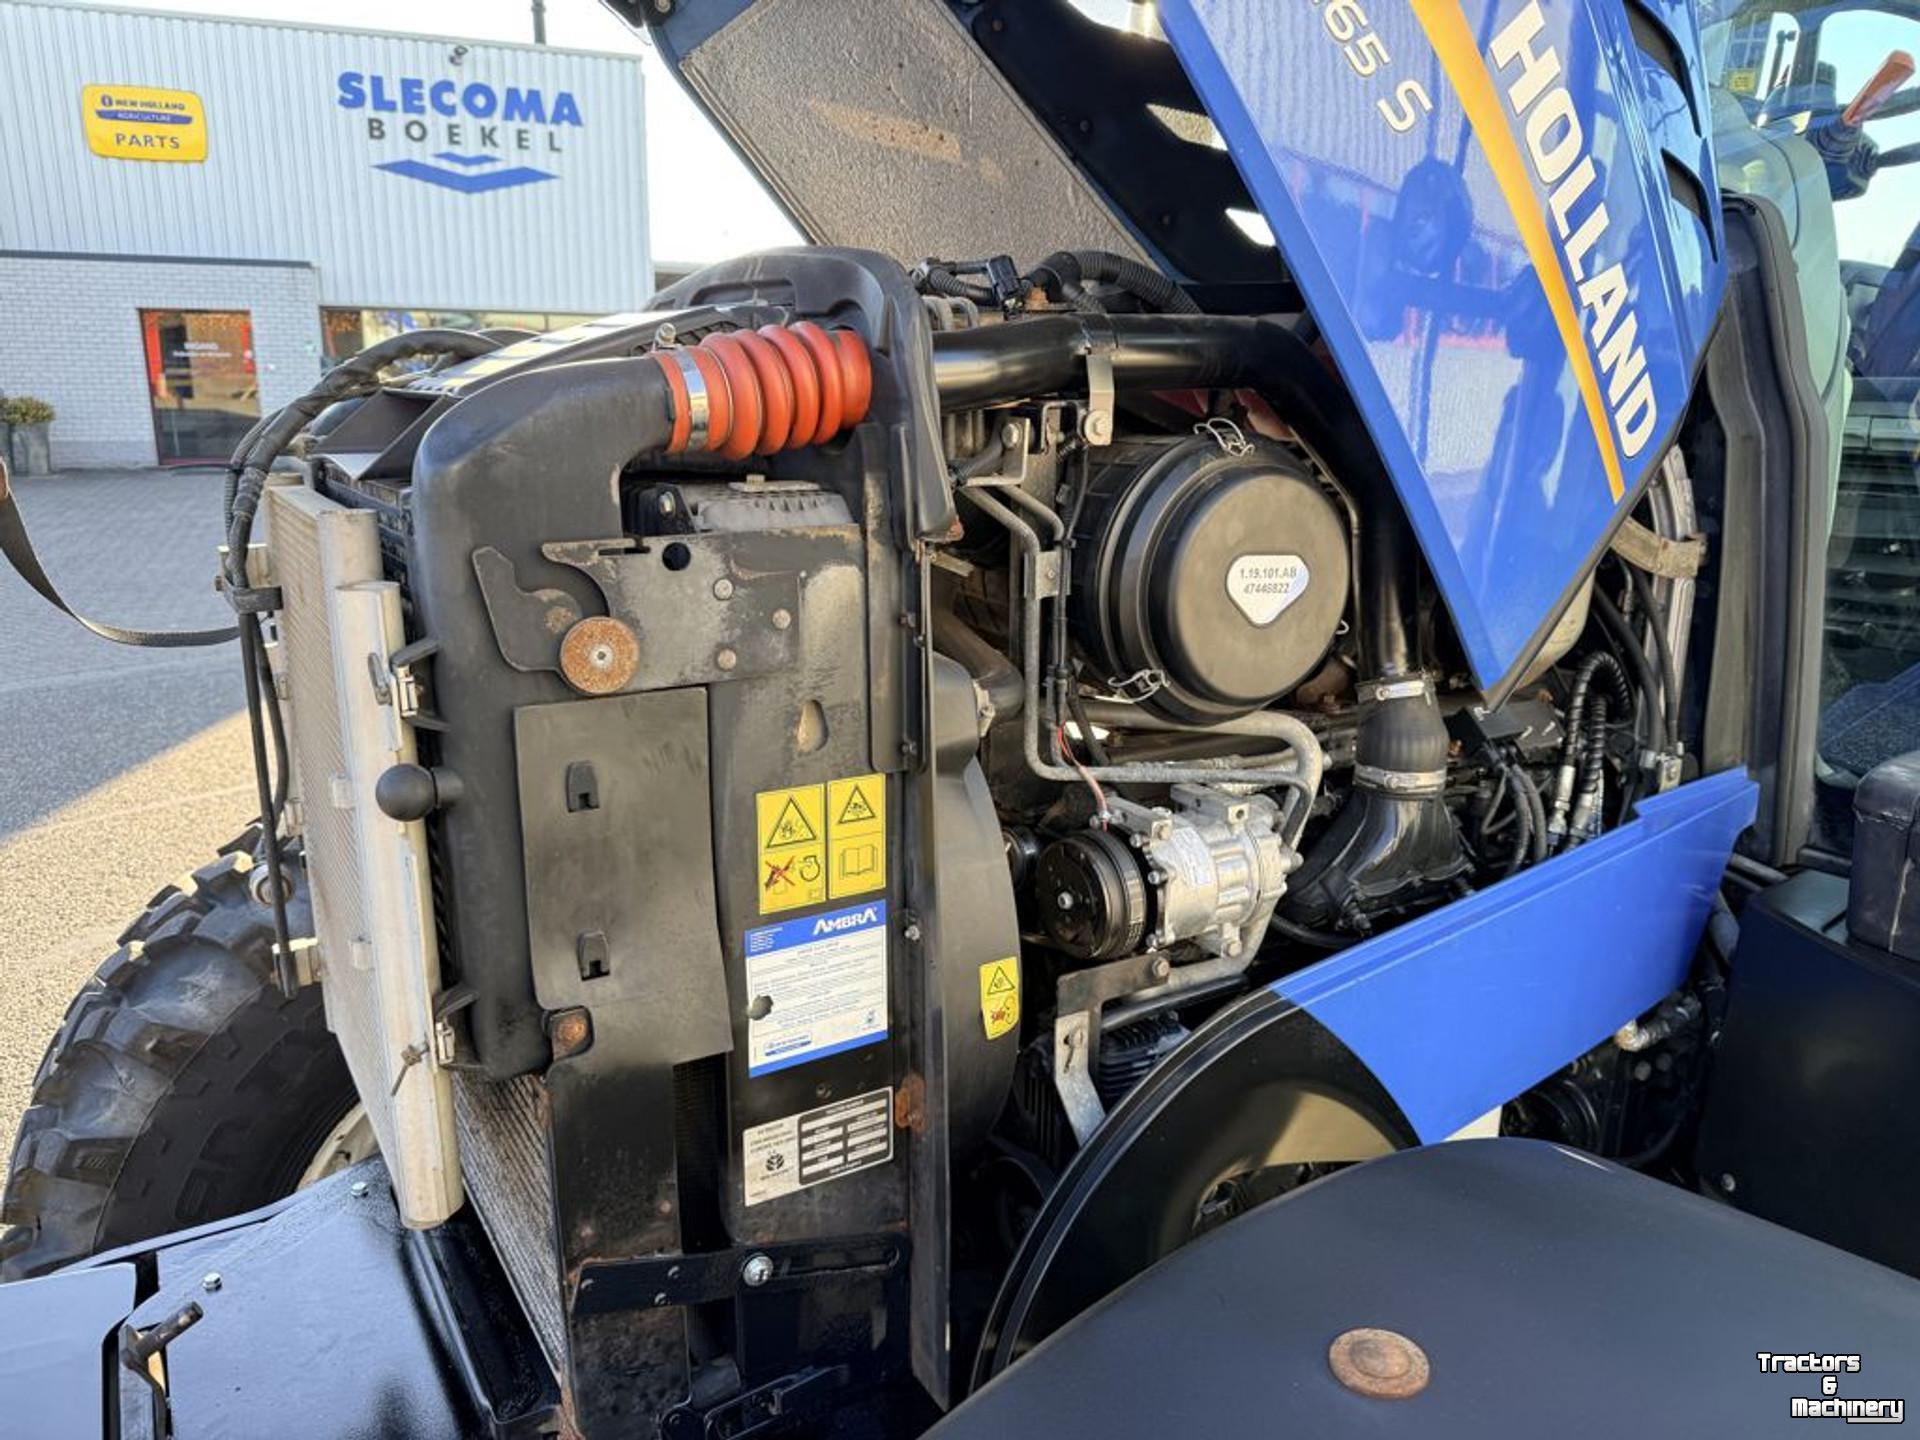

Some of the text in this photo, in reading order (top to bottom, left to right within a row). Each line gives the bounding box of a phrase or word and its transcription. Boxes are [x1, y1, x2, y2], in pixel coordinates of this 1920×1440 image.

[1311, 0, 1433, 133] 65 S
[338, 71, 582, 127] SLECOMA
[115, 133, 180, 149] PARTS
[368, 118, 562, 152] BOEKEL
[1490, 0, 1657, 458] HOLLAND
[813, 907, 877, 935] AMBRA
